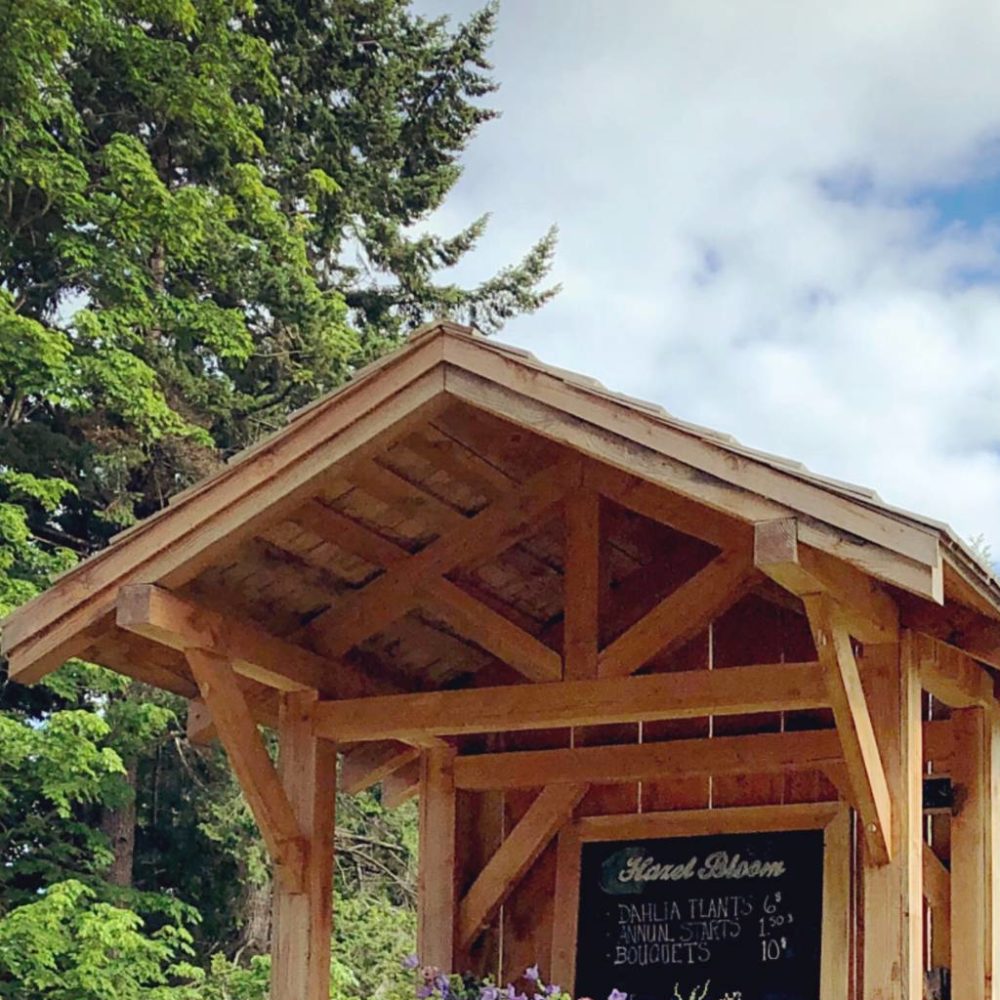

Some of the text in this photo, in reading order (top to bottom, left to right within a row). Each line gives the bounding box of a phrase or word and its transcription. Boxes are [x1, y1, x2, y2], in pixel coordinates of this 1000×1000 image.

[618, 851, 786, 882] Hazel Bloom
[618, 901, 681, 925] DAHLIA
[614, 942, 711, 966] BOUQUETS
